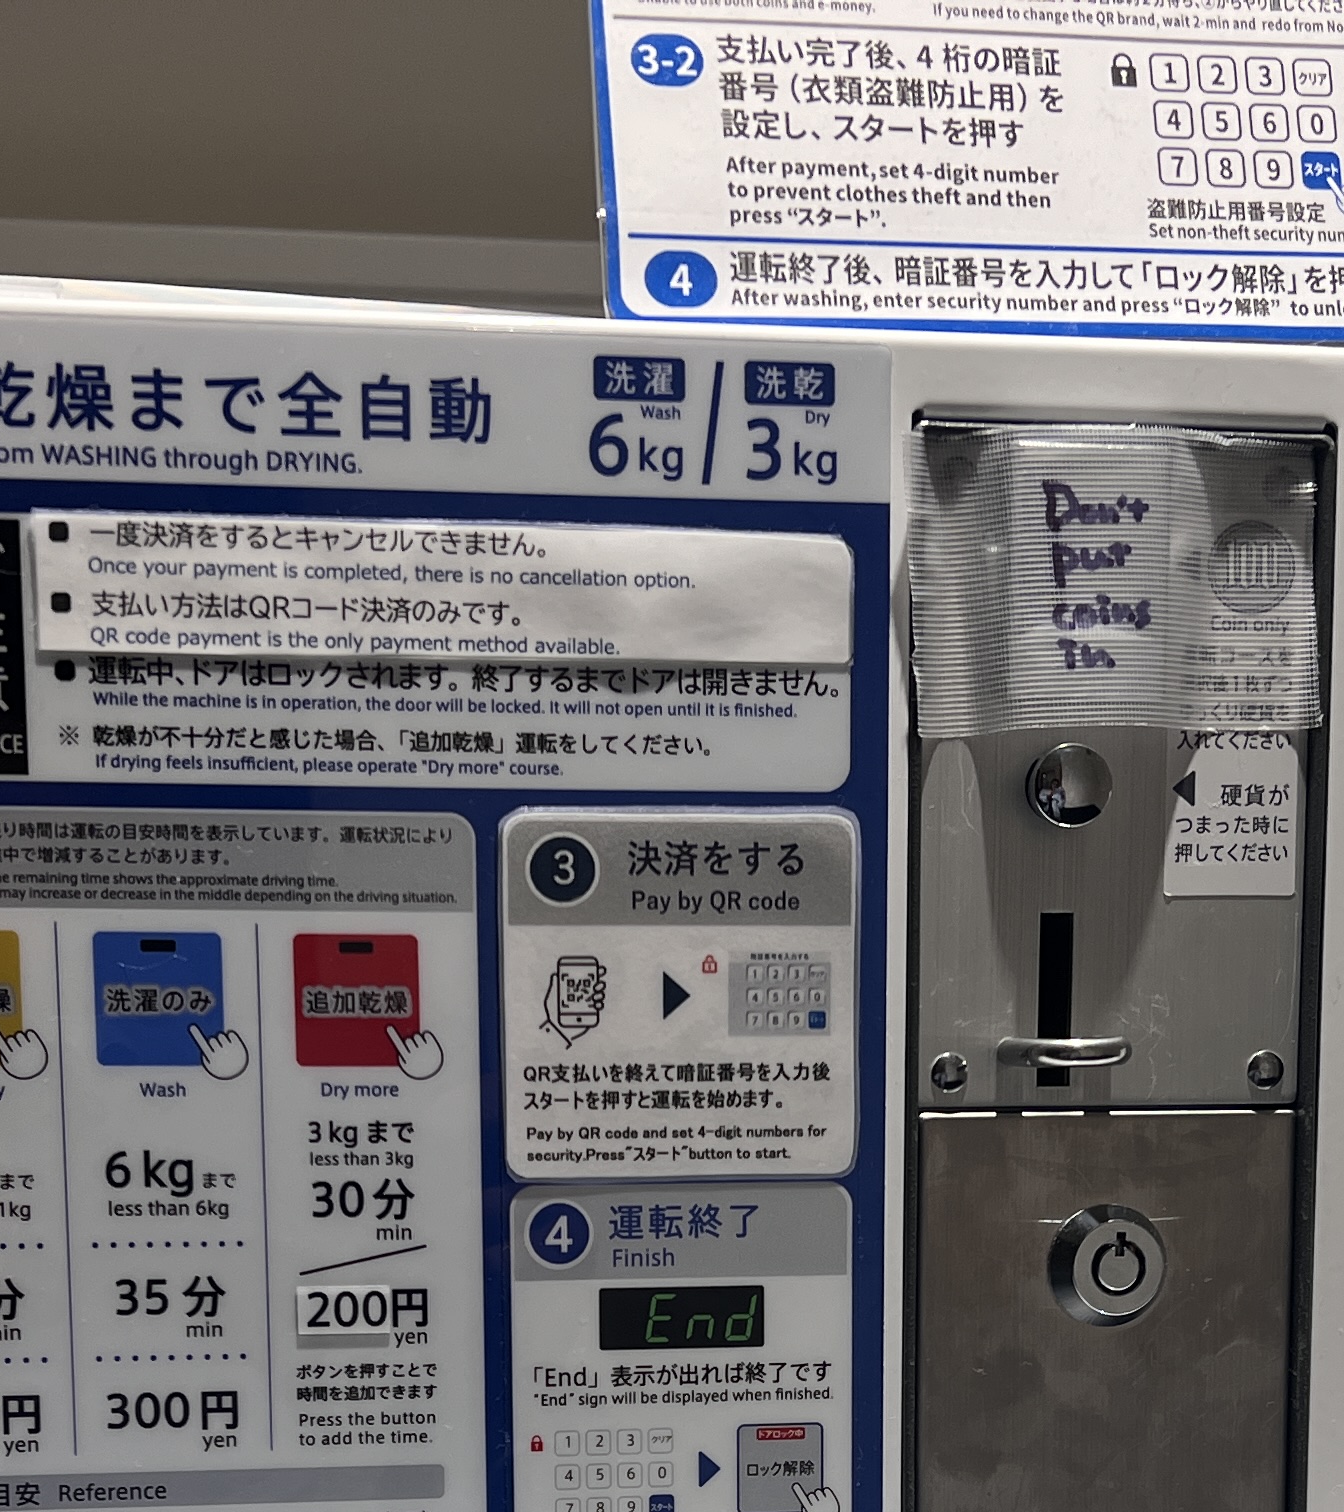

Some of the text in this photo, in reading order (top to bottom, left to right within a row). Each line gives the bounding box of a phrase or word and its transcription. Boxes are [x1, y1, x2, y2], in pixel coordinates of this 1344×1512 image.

[638, 44, 697, 76] 3-2
[722, 109, 1023, 148] 設定し、スタートを押す
[1148, 198, 1325, 223] 盗難防止用番号設定
[1149, 224, 1173, 238] Set
[1177, 226, 1250, 240] non-theft
[1254, 227, 1314, 245] security
[670, 264, 692, 296] 4
[606, 361, 673, 395] 洗濯
[757, 366, 823, 399] 洗乾
[641, 405, 680, 420] Wash
[806, 410, 830, 427] Dry
[41, 444, 156, 467] WASHING
[163, 448, 258, 475] through
[266, 451, 362, 473] DRYING.
[90, 521, 546, 558] 一度決済をするとキャンセルできません。
[88, 556, 695, 590] Once your payment is completed, there is no cancellation option.
[92, 590, 520, 626] 支払い方法はQRコード決済のみです。
[1221, 784, 1289, 806] 硬貨が
[1176, 815, 1288, 834] つまった時に
[554, 840, 803, 884] 3 決済をする
[1175, 843, 1287, 862] 押してください
[632, 889, 799, 914] Pay by QR code
[107, 989, 211, 1012] 洗濯のみ
[307, 991, 407, 1014] 追加乾燥
[140, 1083, 186, 1097] Wash
[321, 1082, 399, 1100] Dry more
[545, 1204, 758, 1252] 4 運転終了
[613, 1248, 674, 1267] Finish
[646, 1294, 757, 1342] End
[747, 1460, 814, 1476] ロック解除
[59, 1483, 166, 1501] Reference
